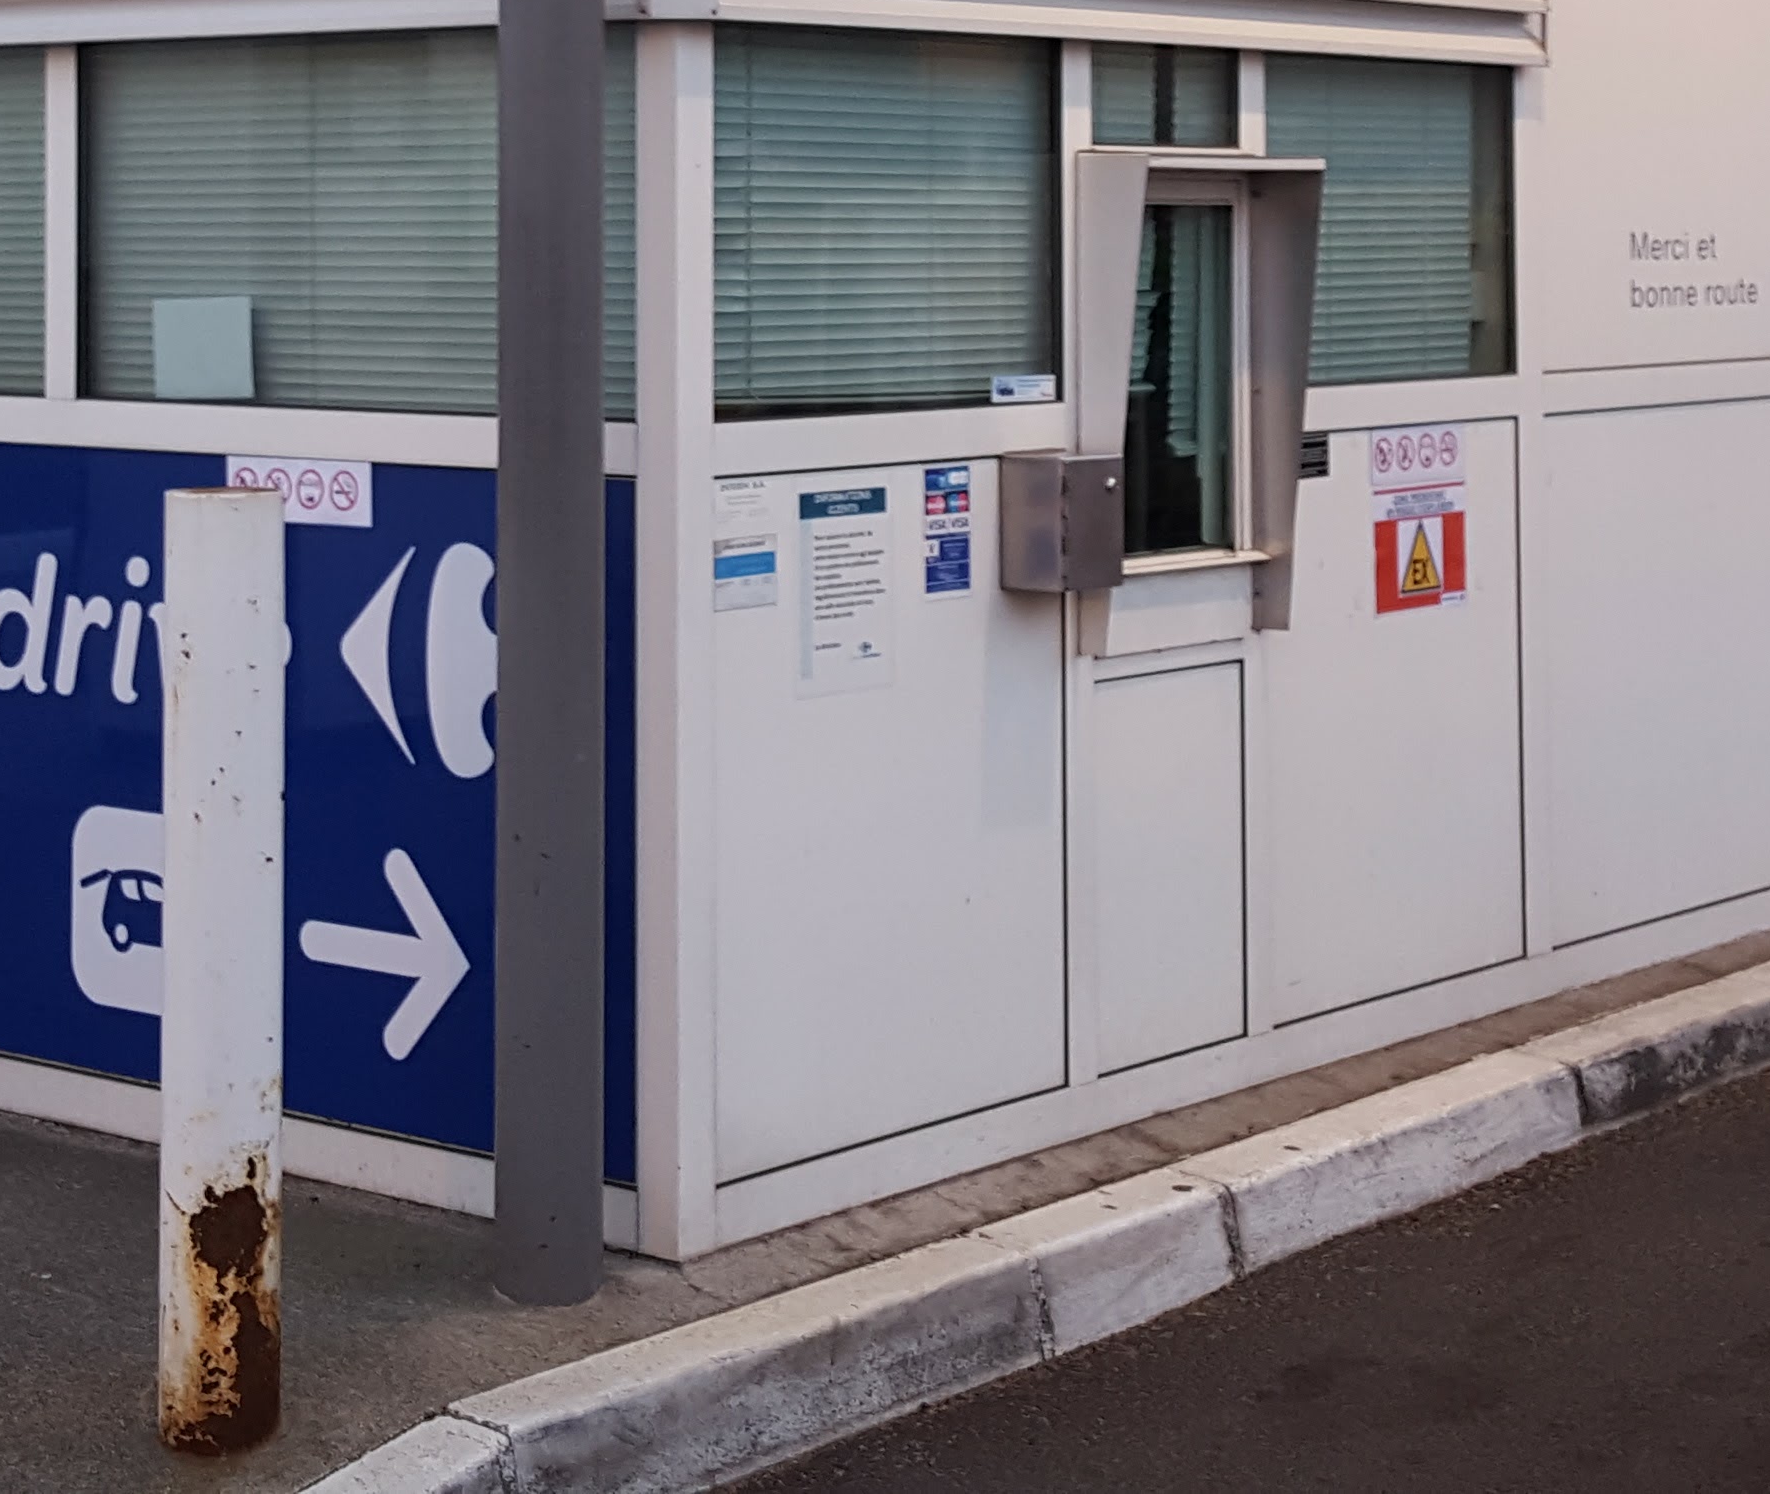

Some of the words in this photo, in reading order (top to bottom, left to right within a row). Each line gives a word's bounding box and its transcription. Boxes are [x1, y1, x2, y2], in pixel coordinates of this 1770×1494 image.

[1630, 231, 1690, 260] Merci
[1696, 235, 1717, 260] et
[1630, 279, 1698, 308] bonne
[1705, 279, 1759, 306] route
